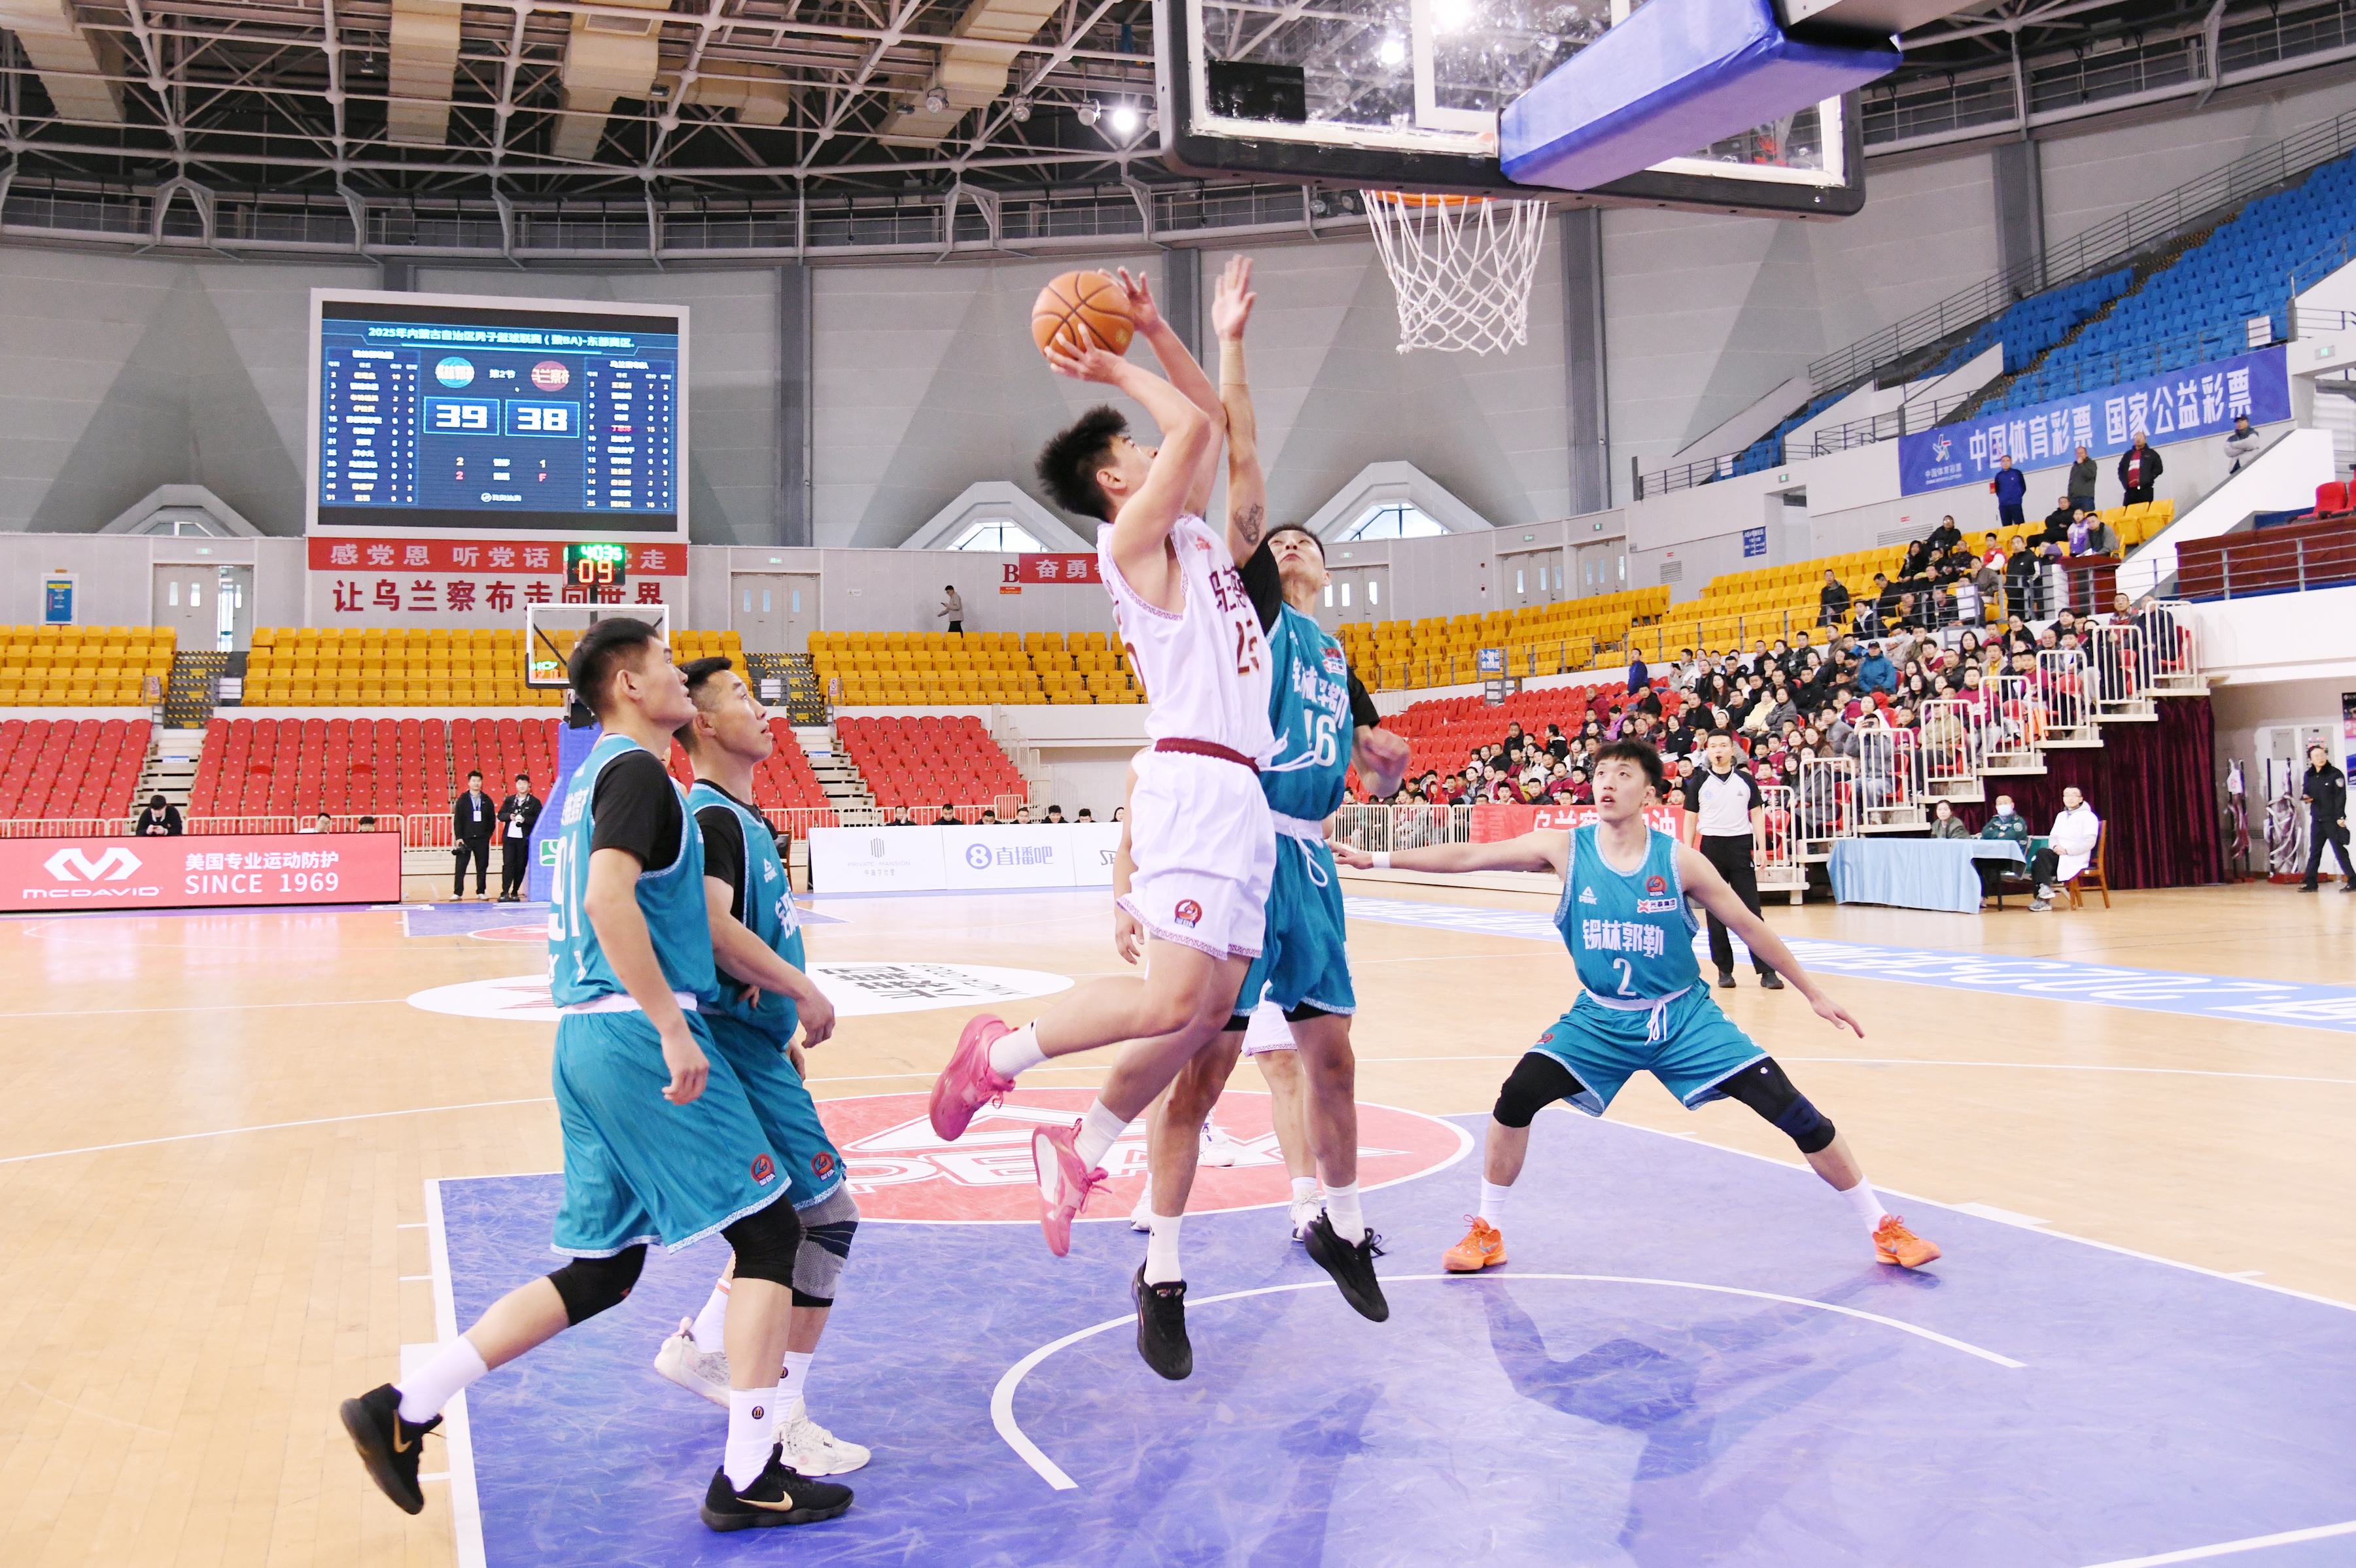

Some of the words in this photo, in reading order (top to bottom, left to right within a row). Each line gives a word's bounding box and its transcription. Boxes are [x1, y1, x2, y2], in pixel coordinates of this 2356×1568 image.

[436, 405, 488, 428] 39
[517, 407, 568, 431] 38
[1969, 402, 2094, 473] 中国体育彩票
[2105, 366, 2253, 445] 国家公益彩票
[456, 456, 464, 466] 2
[539, 459, 547, 468] 1
[455, 471, 464, 480] 2
[538, 473, 547, 482] F
[330, 543, 430, 566] 感党恩
[453, 545, 551, 569] 听党话
[578, 558, 614, 584] 09
[1002, 564, 1019, 583] B
[1035, 559, 1100, 579] 奋勇
[332, 578, 665, 613] 让乌兰察布走向世界
[1304, 708, 1337, 767] 16
[185, 851, 340, 872] 美国专业运动防护
[995, 845, 1054, 866] 直播吧
[185, 873, 263, 895] SINCE
[279, 871, 339, 893] 1969
[548, 830, 581, 942] 91
[1582, 918, 1665, 960] 锡林郭勒
[1613, 957, 1638, 997] 2
